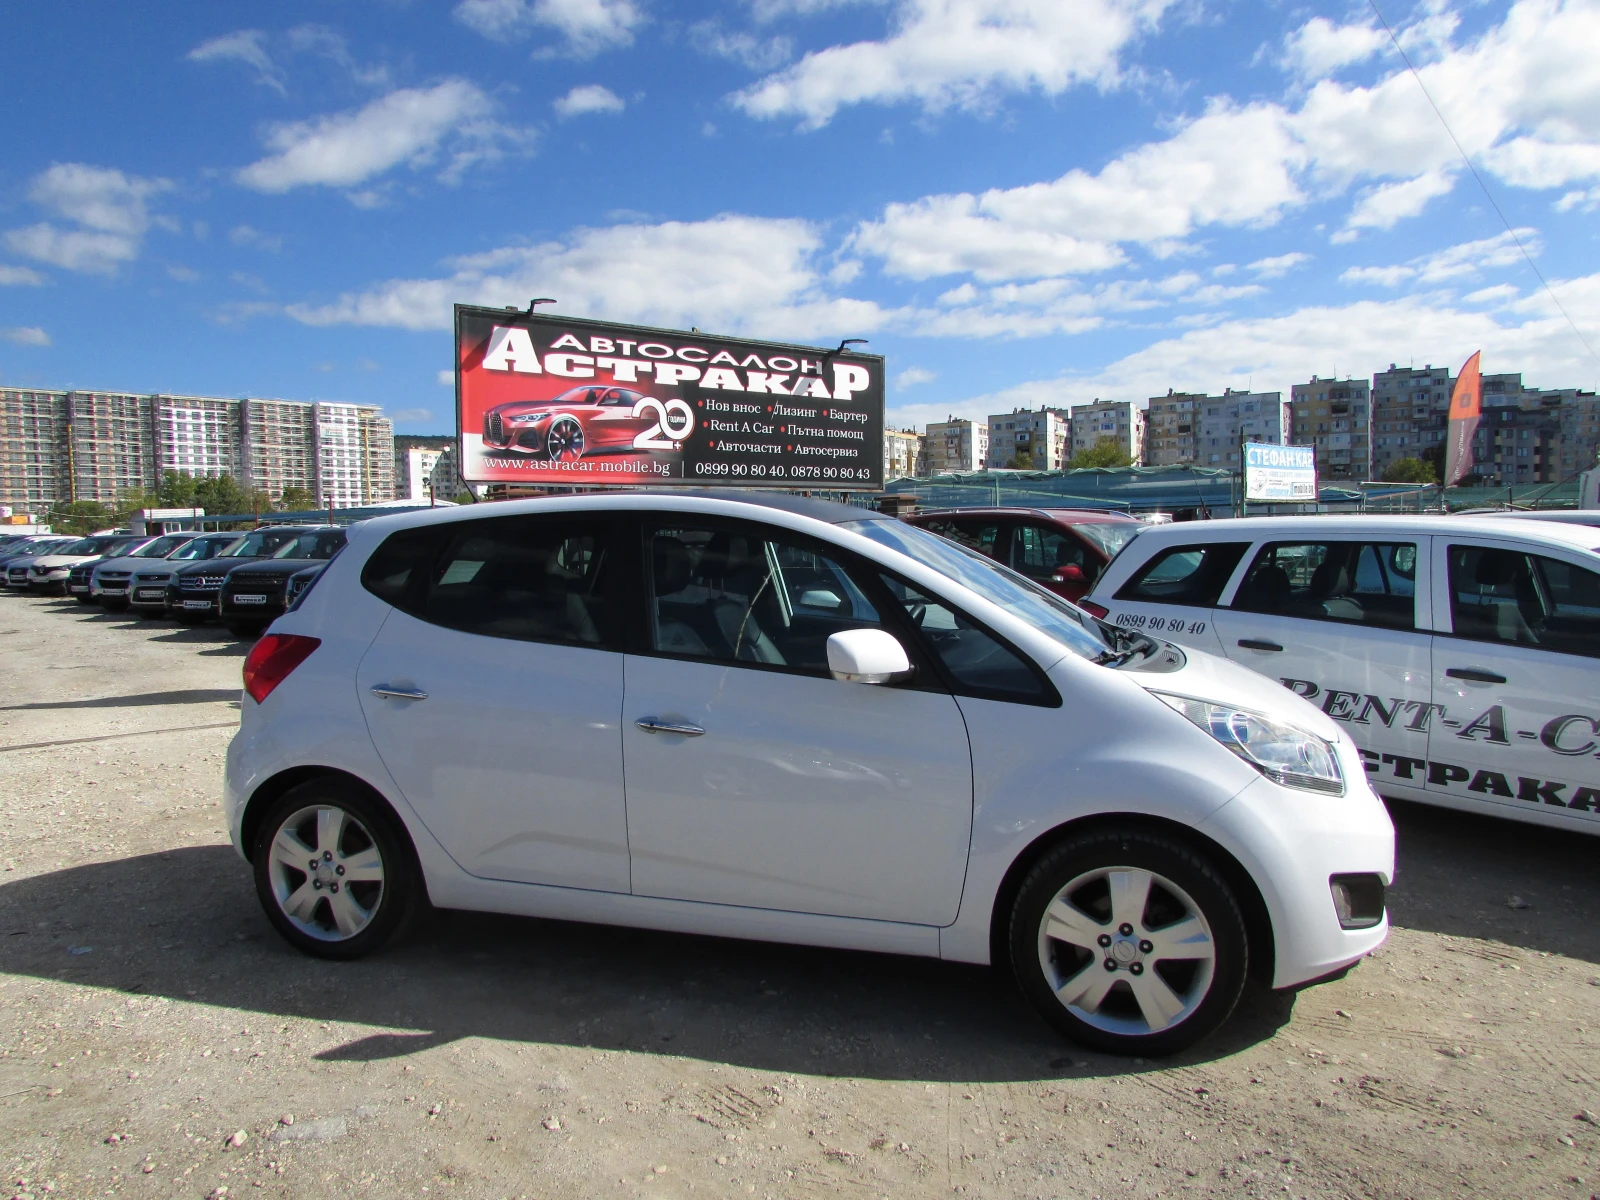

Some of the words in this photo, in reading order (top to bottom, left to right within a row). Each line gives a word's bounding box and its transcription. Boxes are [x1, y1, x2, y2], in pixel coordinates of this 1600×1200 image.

[550, 334, 823, 375] АВТОСАЛОН
[482, 325, 870, 401] АСТРАКАР
[706, 399, 730, 412] Нов
[732, 403, 761, 414] внос
[774, 404, 818, 418] Лизинг
[829, 409, 868, 424] Бартер
[710, 419, 739, 432] Rent
[741, 422, 750, 433] A
[753, 422, 775, 434] Car
[787, 425, 824, 437] Пътна
[826, 429, 864, 441] помощ
[716, 440, 782, 454] Авточасти
[794, 444, 859, 458] Автосервиз
[483, 457, 671, 477] www.astracar.mobile.bg
[695, 463, 729, 475] 0899
[731, 464, 748, 476] 90
[750, 464, 766, 477] 80
[790, 466, 821, 478] 0878
[823, 466, 838, 479] 90
[839, 467, 854, 479] 80
[856, 468, 871, 480] 43
[1115, 613, 1146, 628] 0899
[1148, 616, 1165, 630] 90
[1167, 618, 1185, 632] 80
[1187, 621, 1206, 635] 40
[1280, 677, 1600, 758] RENT-A-C
